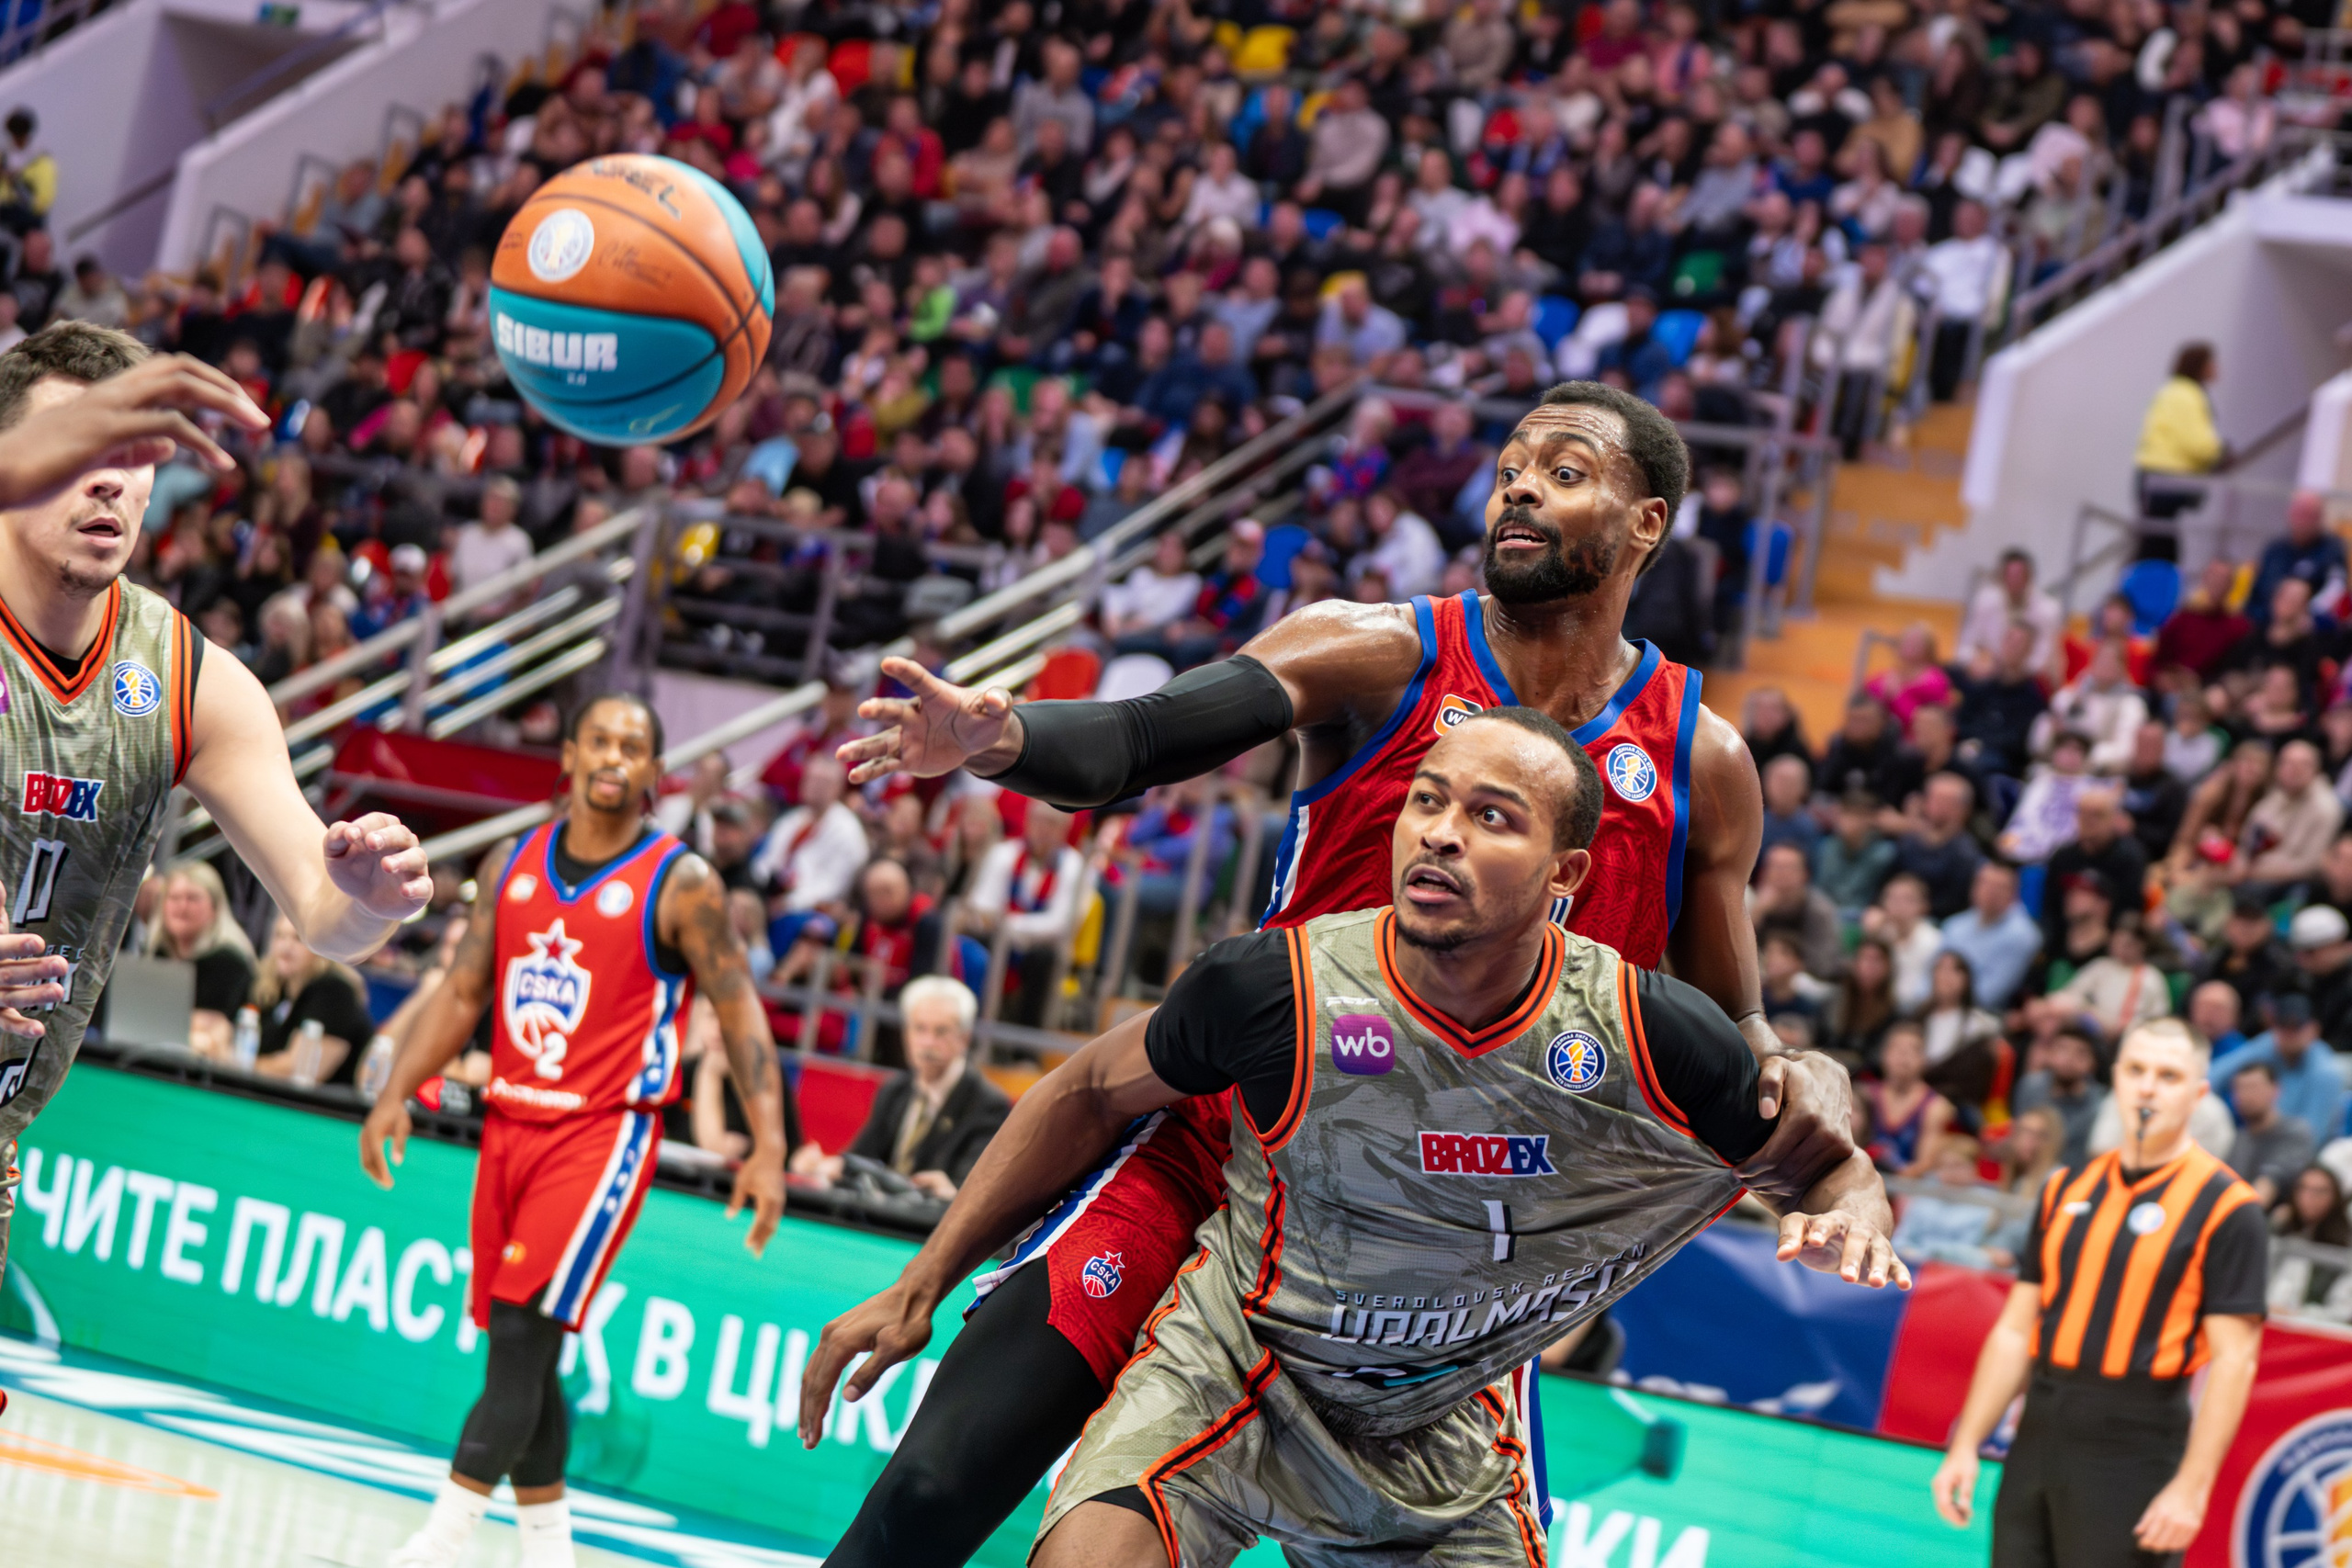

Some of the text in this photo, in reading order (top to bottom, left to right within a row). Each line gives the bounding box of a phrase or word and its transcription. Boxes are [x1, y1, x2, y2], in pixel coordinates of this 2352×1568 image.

[497, 312, 617, 371] SIBUR
[519, 972, 576, 1004] CSKA
[534, 1032, 568, 1081] 2
[1335, 1027, 1390, 1057] wb
[1419, 1133, 1555, 1176] BROZEX
[1481, 1200, 1514, 1262] 1
[9, 1147, 219, 1285] ЧИТЕ
[220, 1196, 628, 1385] ПЛАСК
[632, 1296, 695, 1400] В
[1090, 1261, 1117, 1288] CSKA
[1335, 1281, 1523, 1310] SVERDLOVSK
[1550, 1495, 1711, 1568] КИ
